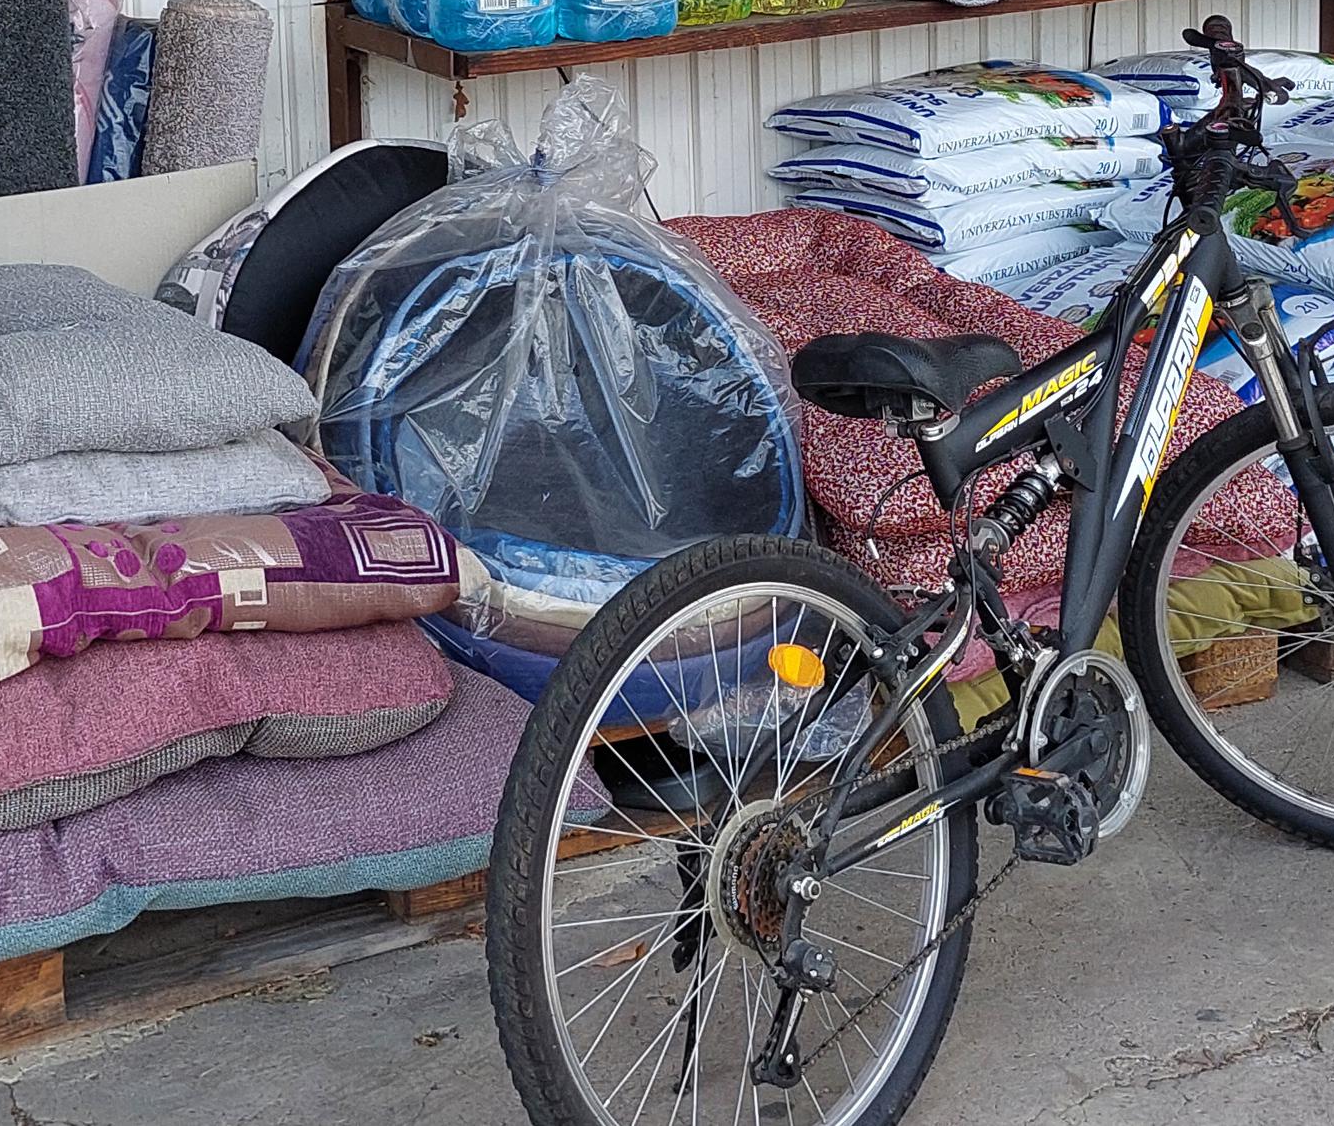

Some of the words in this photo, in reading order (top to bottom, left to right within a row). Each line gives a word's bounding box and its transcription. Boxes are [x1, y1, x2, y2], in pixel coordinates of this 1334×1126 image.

[937, 128, 1014, 155] UNIVERZÁLNY
[960, 213, 1035, 241] UNIVERZÁLNY
[1020, 350, 1098, 413] MAGIC
